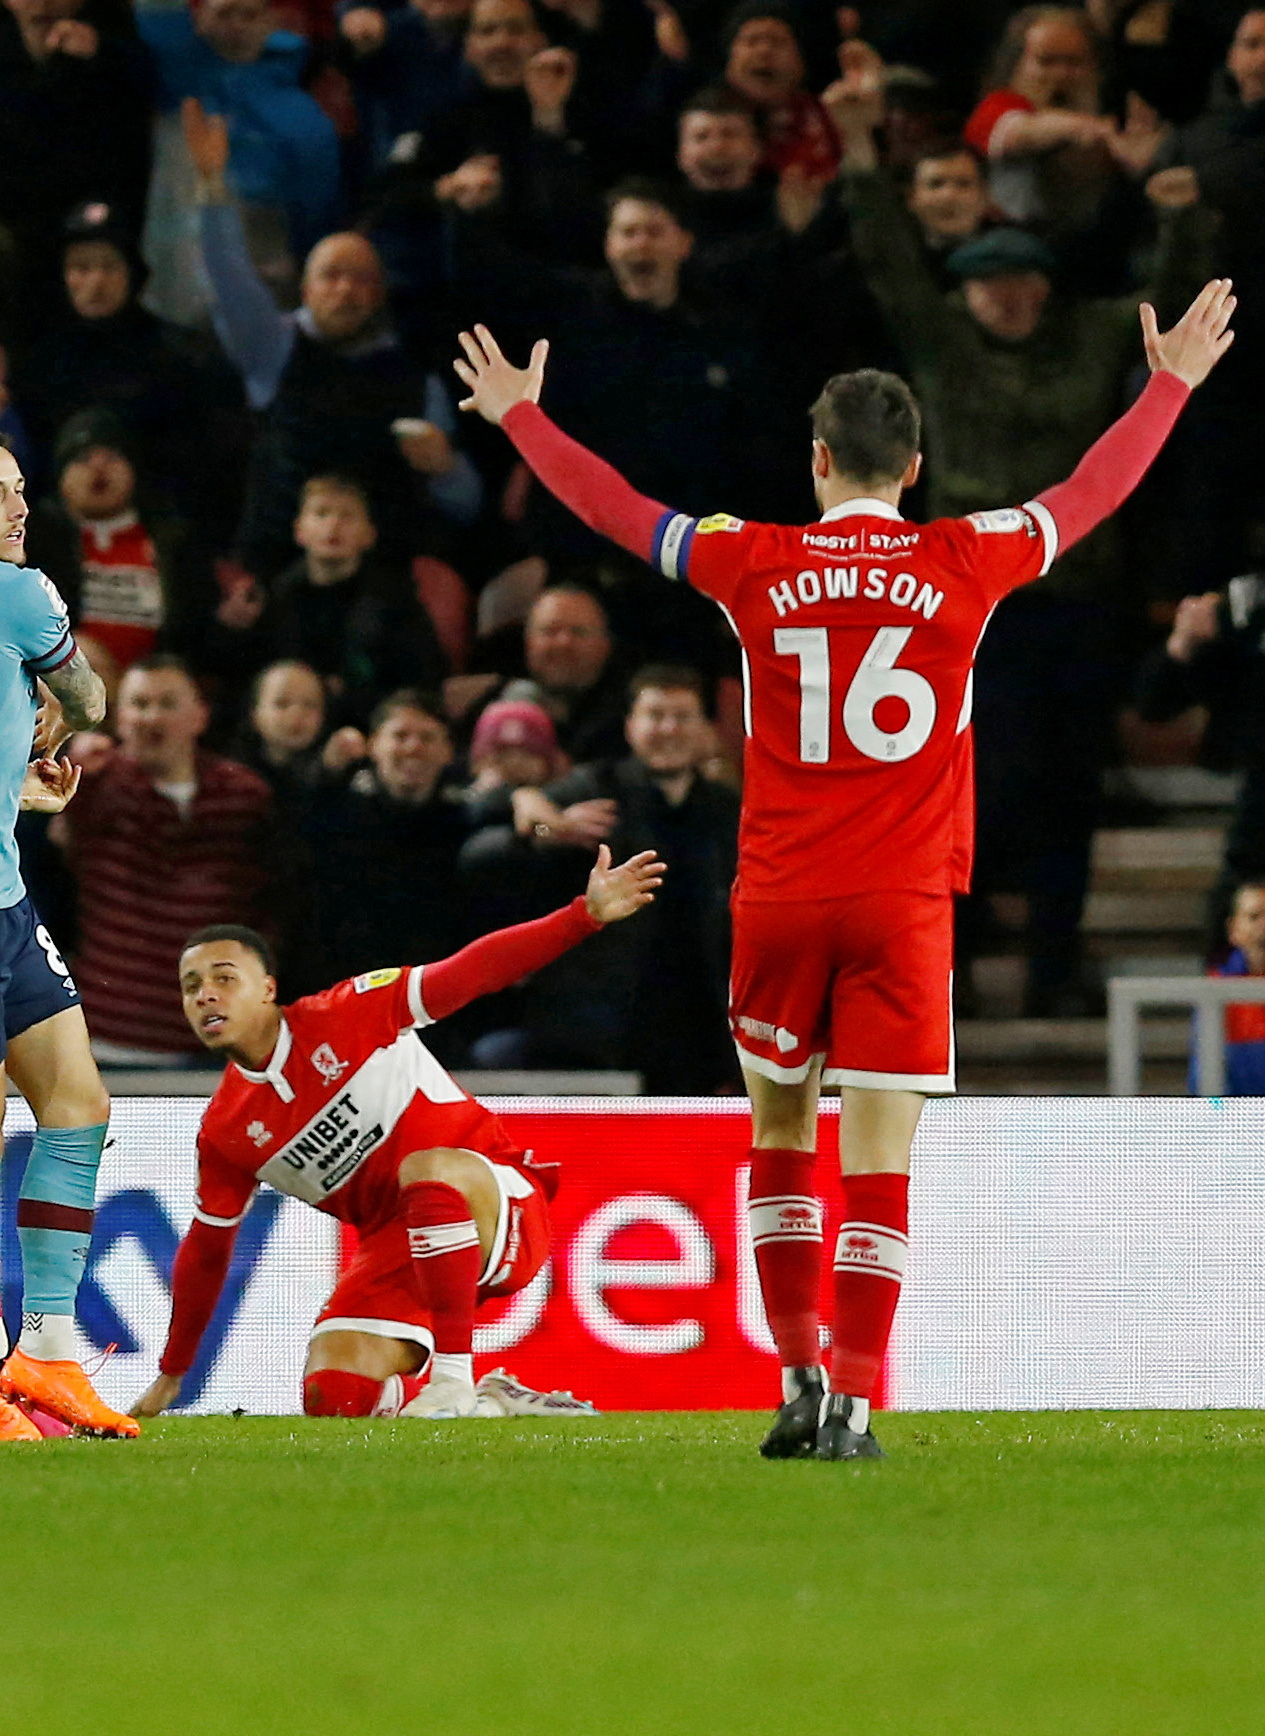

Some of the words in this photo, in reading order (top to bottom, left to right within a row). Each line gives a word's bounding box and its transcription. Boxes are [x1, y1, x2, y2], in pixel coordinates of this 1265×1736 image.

[768, 566, 944, 620] HOWSON
[773, 626, 937, 764] 16
[36, 924, 70, 976] 8
[282, 1093, 359, 1170] UNIBET
